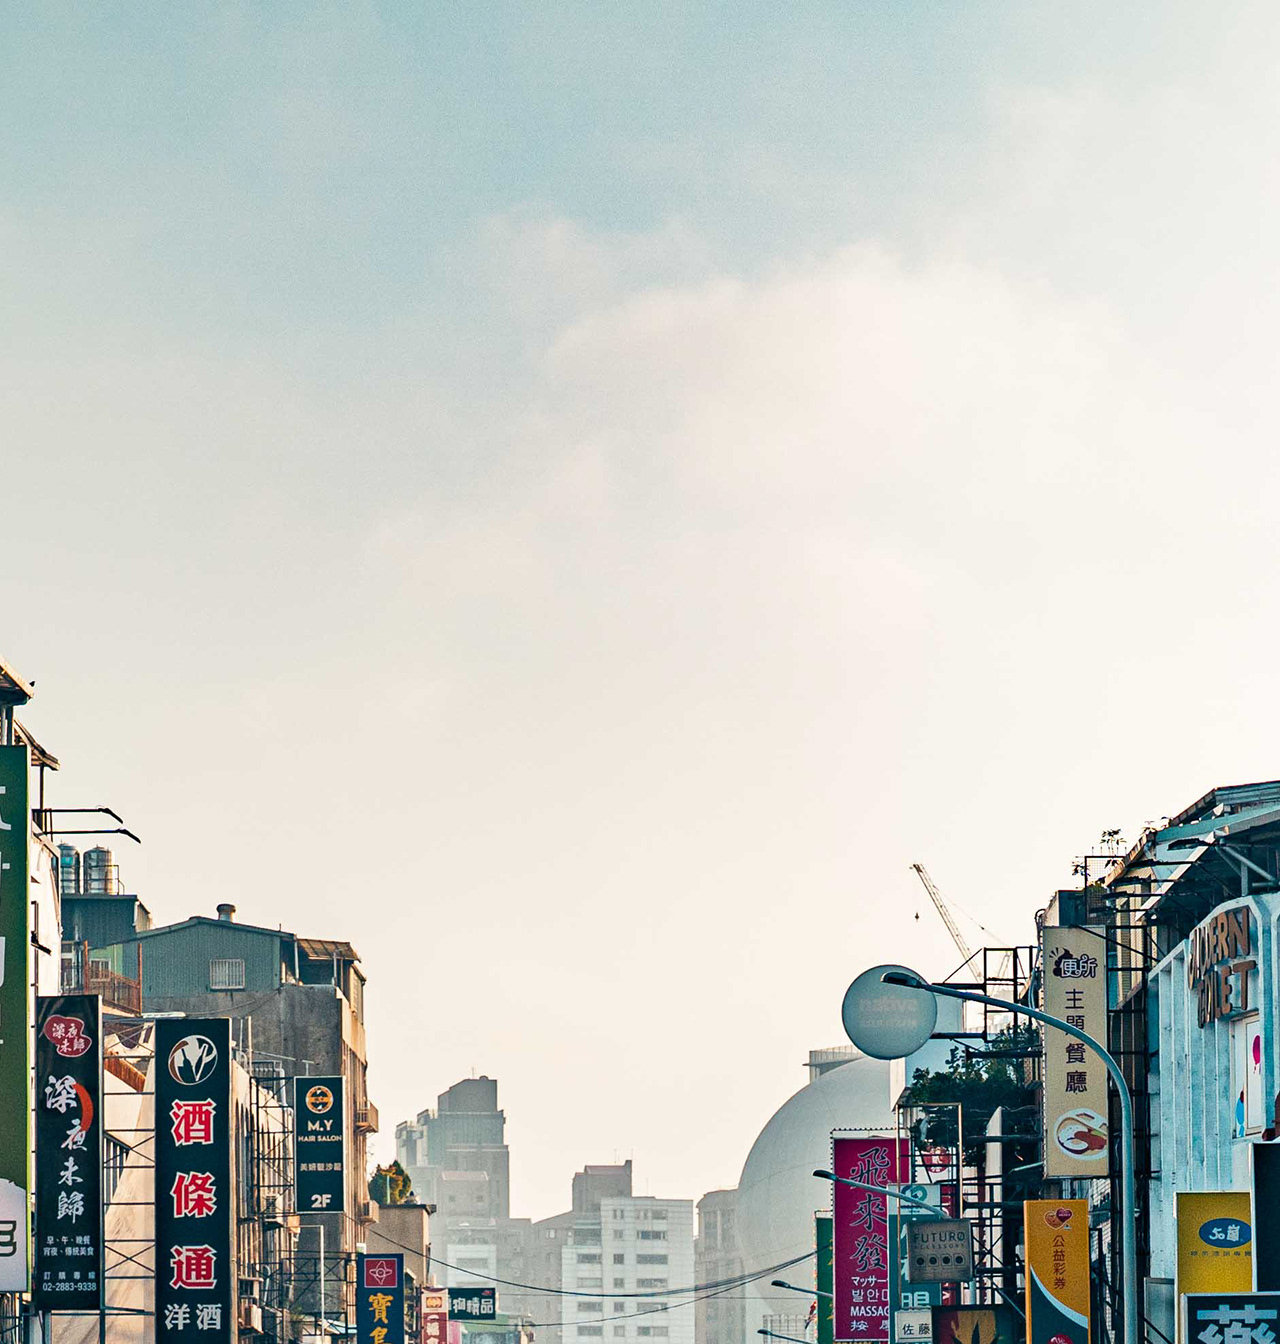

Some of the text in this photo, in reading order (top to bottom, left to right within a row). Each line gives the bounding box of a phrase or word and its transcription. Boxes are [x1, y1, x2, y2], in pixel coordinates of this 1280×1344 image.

[1060, 955, 1097, 978] 便所
[307, 1120, 333, 1132] M.Y
[298, 1134, 342, 1143] HAIR SALON
[45, 1075, 88, 1223] 深夜未歸
[169, 1097, 217, 1291] 酒條通
[311, 1193, 332, 1209] 2F
[1053, 1234, 1067, 1290] 公益彩券
[42, 1281, 97, 1292] 02-2883-9338
[851, 1276, 889, 1287] マッサー
[164, 1303, 222, 1331] 洋酒
[850, 1306, 889, 1316] MASSAG
